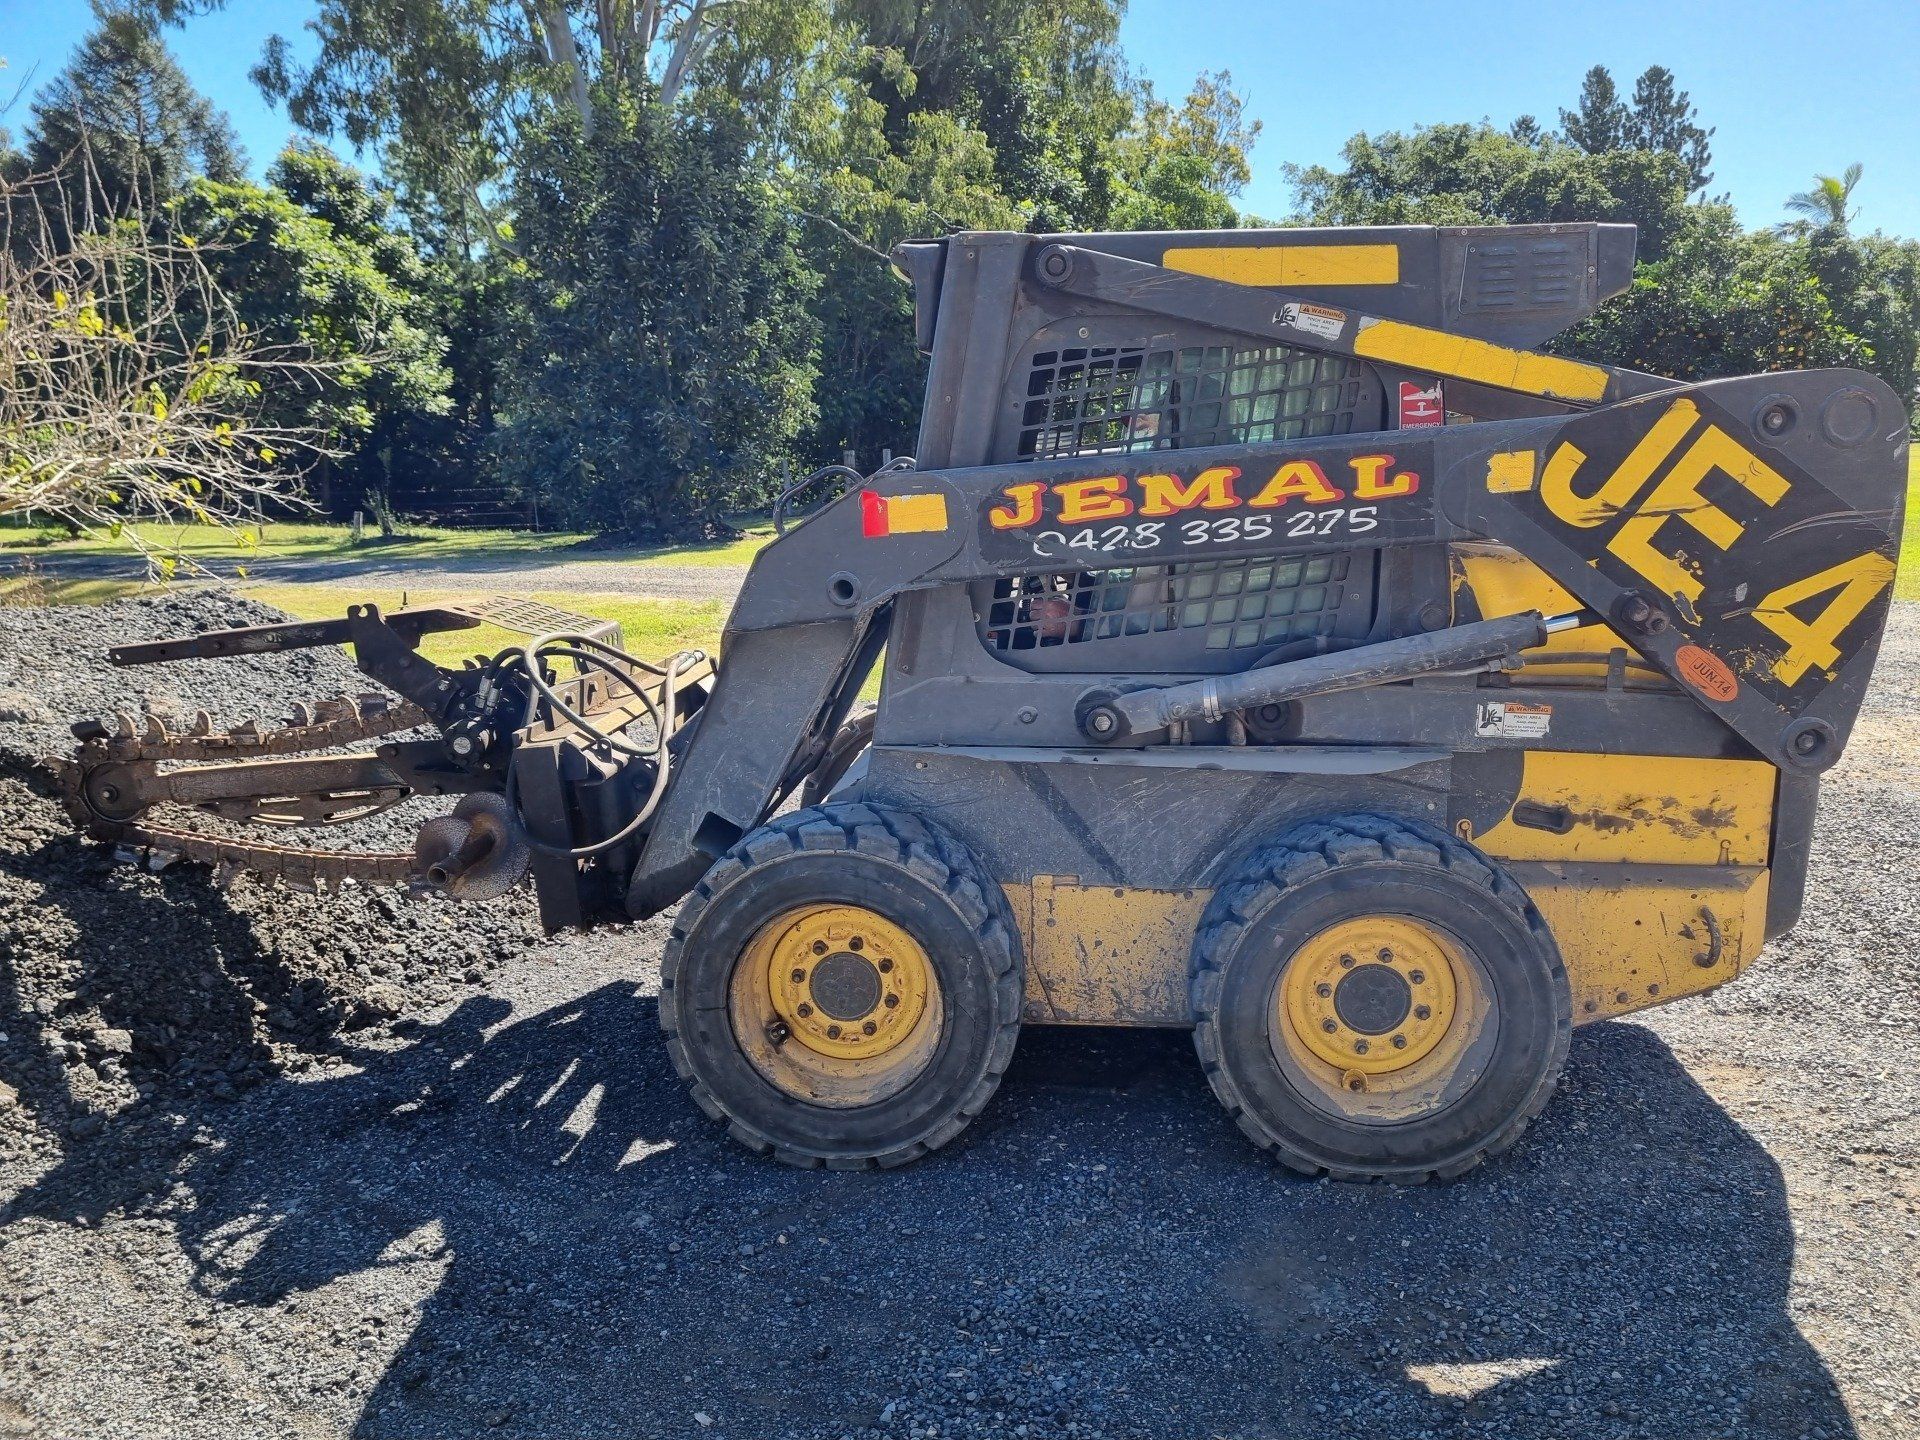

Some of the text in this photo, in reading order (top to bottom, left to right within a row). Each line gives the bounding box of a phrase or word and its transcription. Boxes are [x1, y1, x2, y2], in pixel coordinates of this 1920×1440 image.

[1311, 307, 1343, 318] WARNING
[1402, 422, 1440, 430] EMERGENCY
[987, 454, 1420, 530] JEMAL
[1034, 506, 1378, 556] 0428 335 275
[1693, 662, 1731, 694] JUN-14
